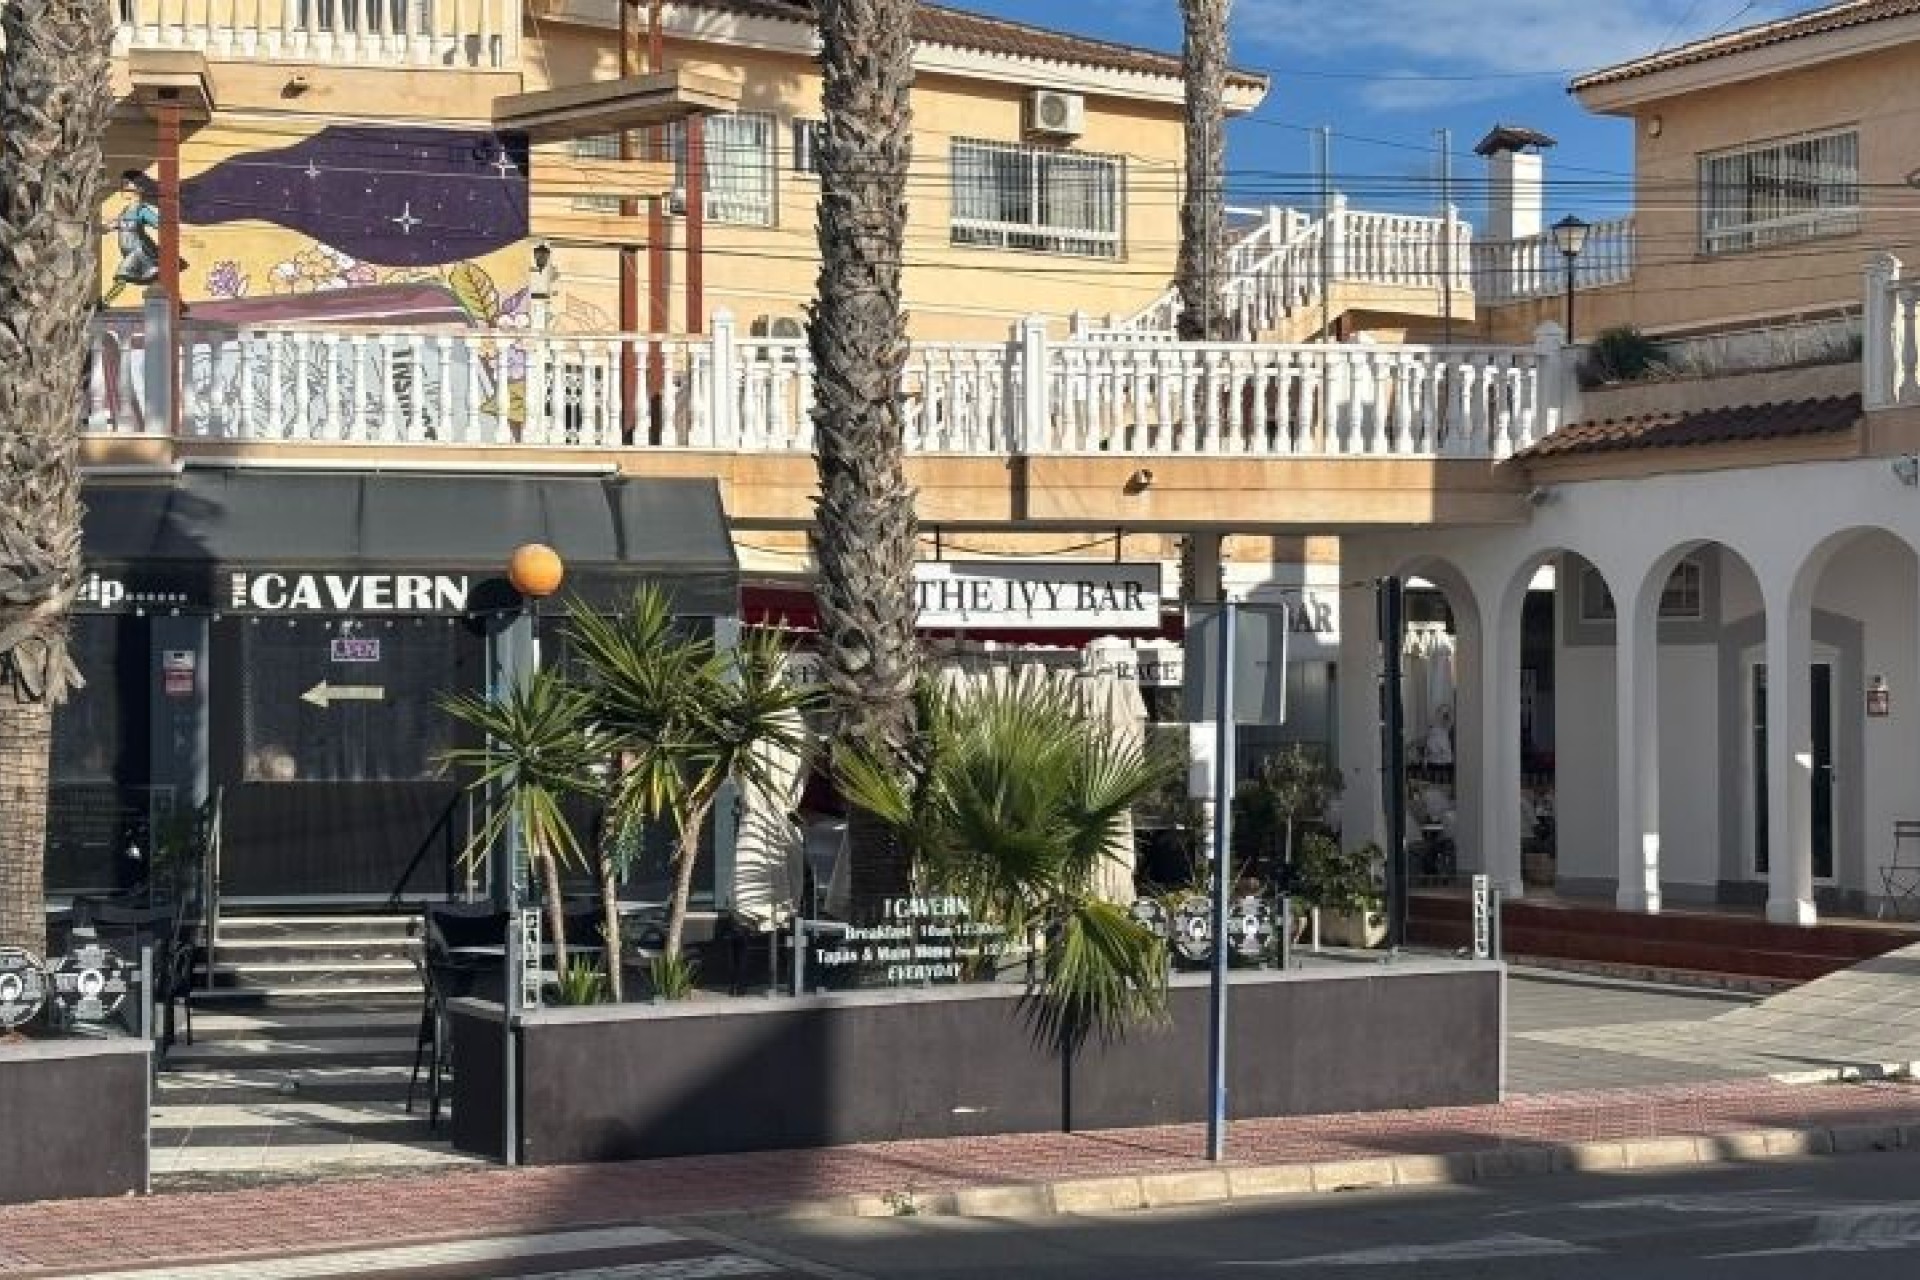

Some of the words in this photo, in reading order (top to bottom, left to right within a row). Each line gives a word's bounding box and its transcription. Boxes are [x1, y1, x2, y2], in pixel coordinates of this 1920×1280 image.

[231, 572, 247, 608] THE
[251, 573, 468, 610] CAVERN
[917, 579, 994, 612] THE
[1002, 579, 1064, 612] IVY
[1074, 579, 1147, 612] BAR
[893, 896, 971, 918] CAVERN
